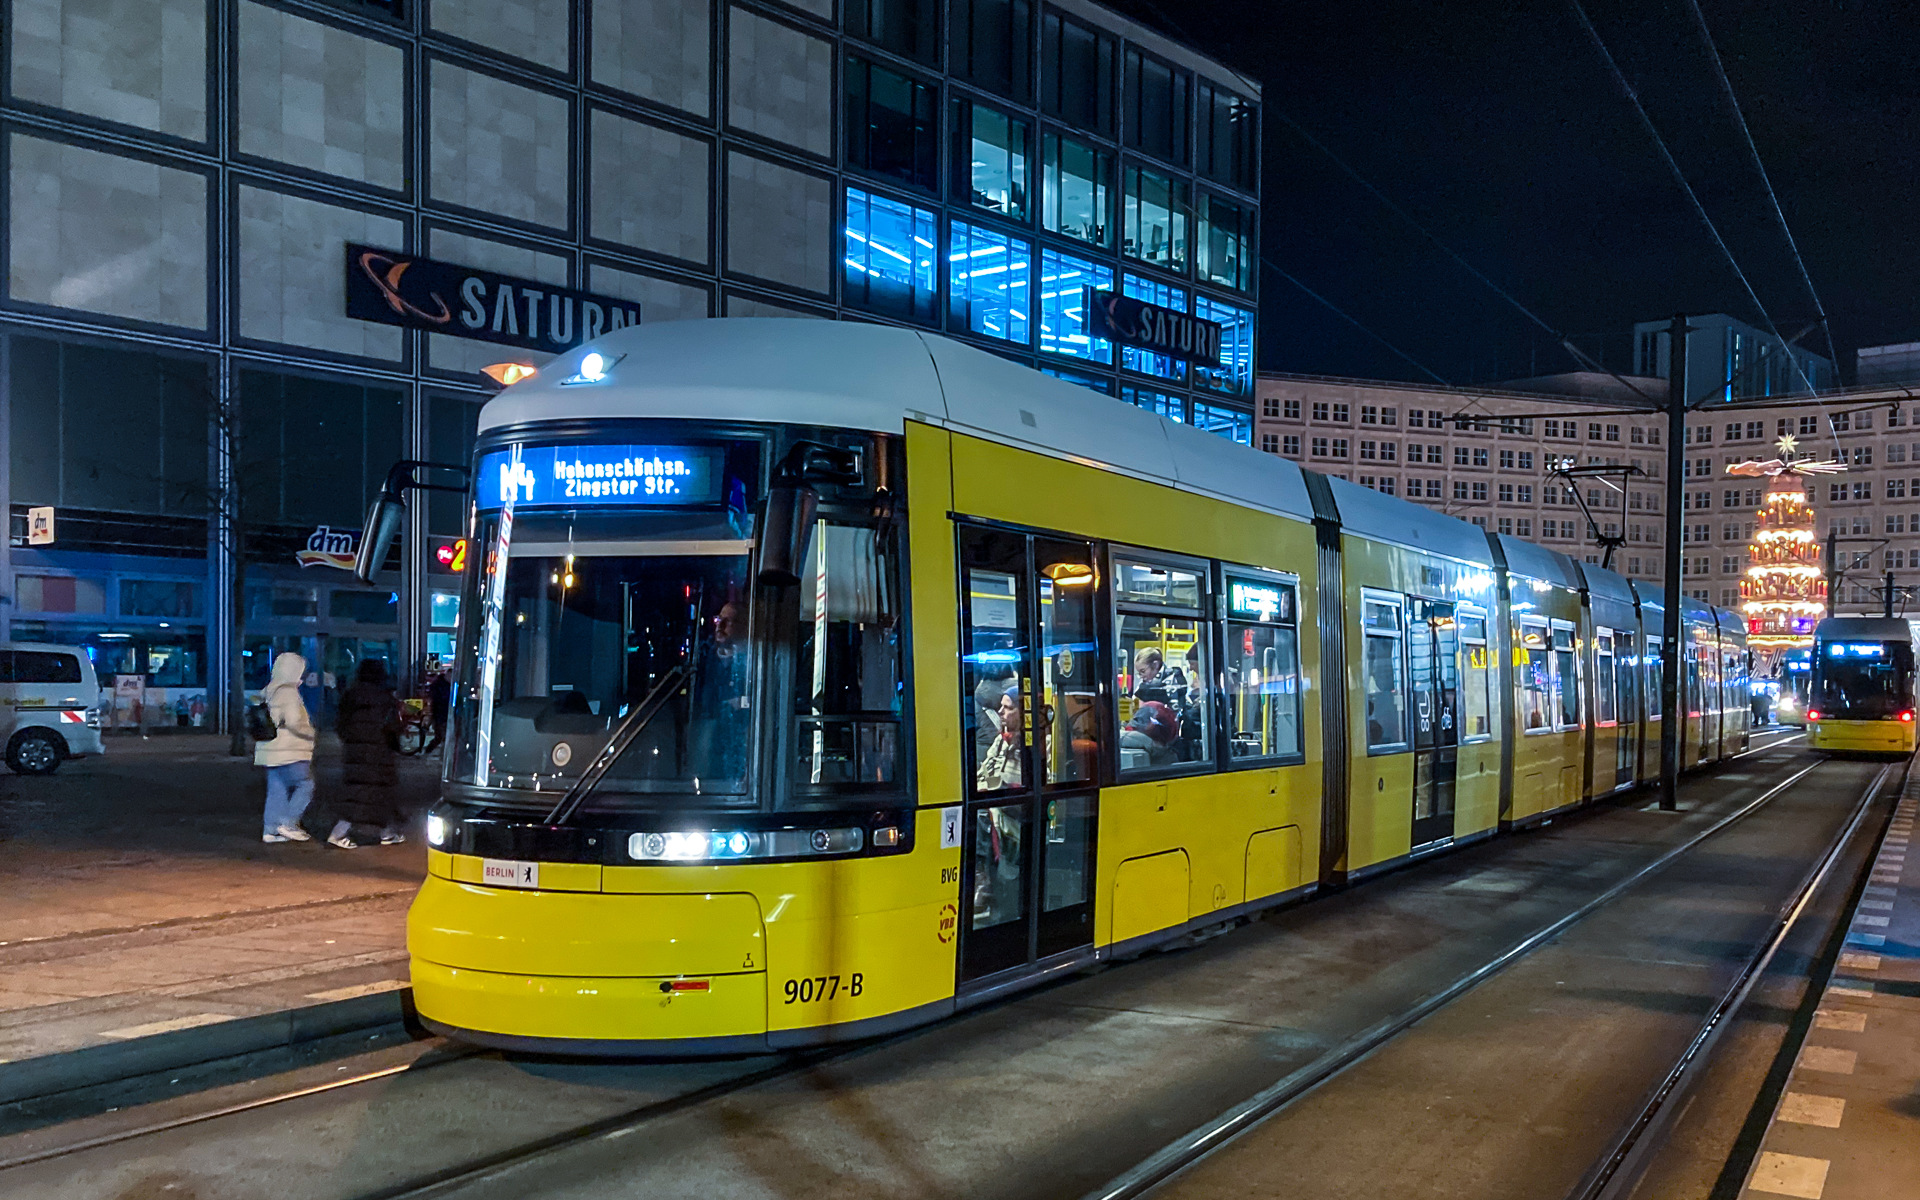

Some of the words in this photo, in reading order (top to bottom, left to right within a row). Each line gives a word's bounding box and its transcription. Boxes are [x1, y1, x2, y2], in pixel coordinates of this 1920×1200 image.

[1141, 306, 1221, 360] SATURN
[565, 477, 638, 497] Zingster
[645, 476, 680, 494] Str.
[35, 512, 47, 529] dm
[308, 526, 352, 553] dm
[486, 866, 515, 879] BERLIN
[941, 866, 958, 884] BVG
[940, 917, 954, 931] VBB
[784, 973, 863, 1005] 9077-B
